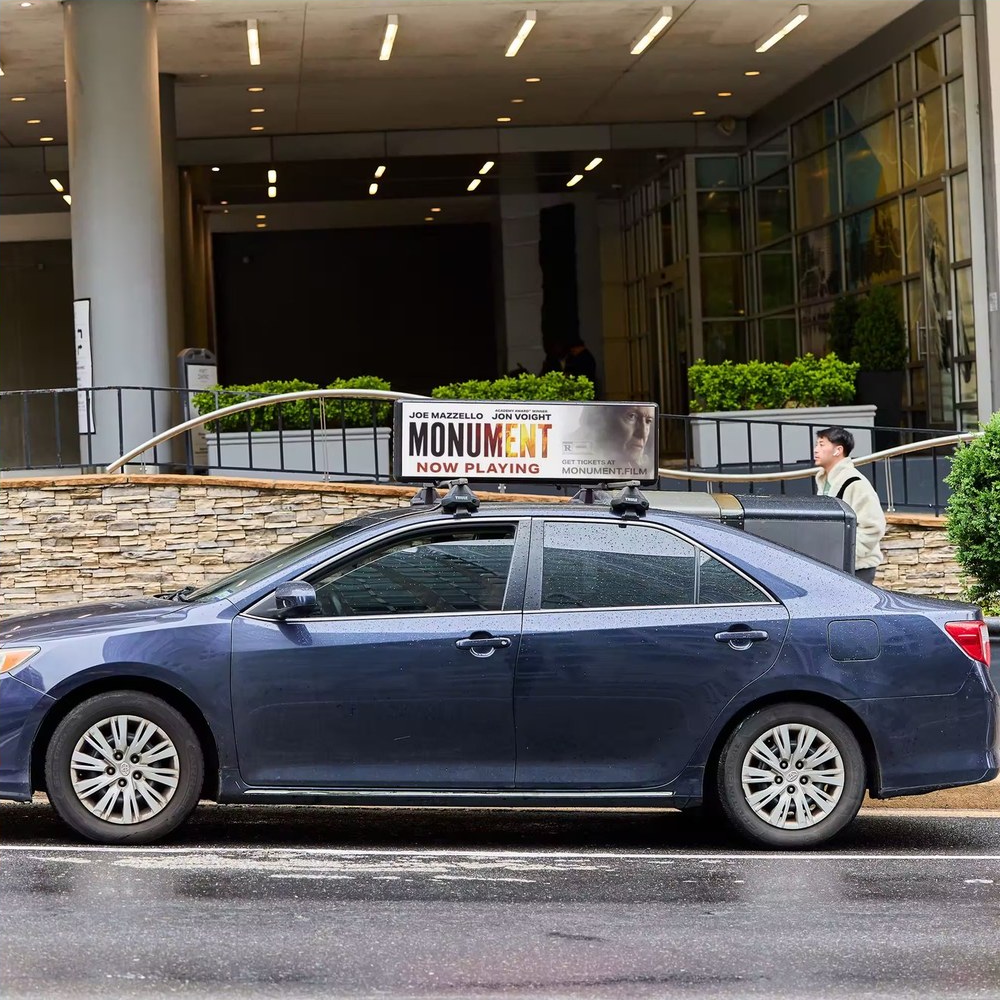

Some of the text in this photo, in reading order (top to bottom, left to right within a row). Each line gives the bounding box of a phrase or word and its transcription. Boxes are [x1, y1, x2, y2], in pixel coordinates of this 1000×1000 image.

[431, 412, 483, 420] MAZZELLO
[409, 422, 552, 458] MONUMENT
[416, 462, 540, 474] NOW PLAYING
[562, 467, 647, 475] MONUMENT.FILM
